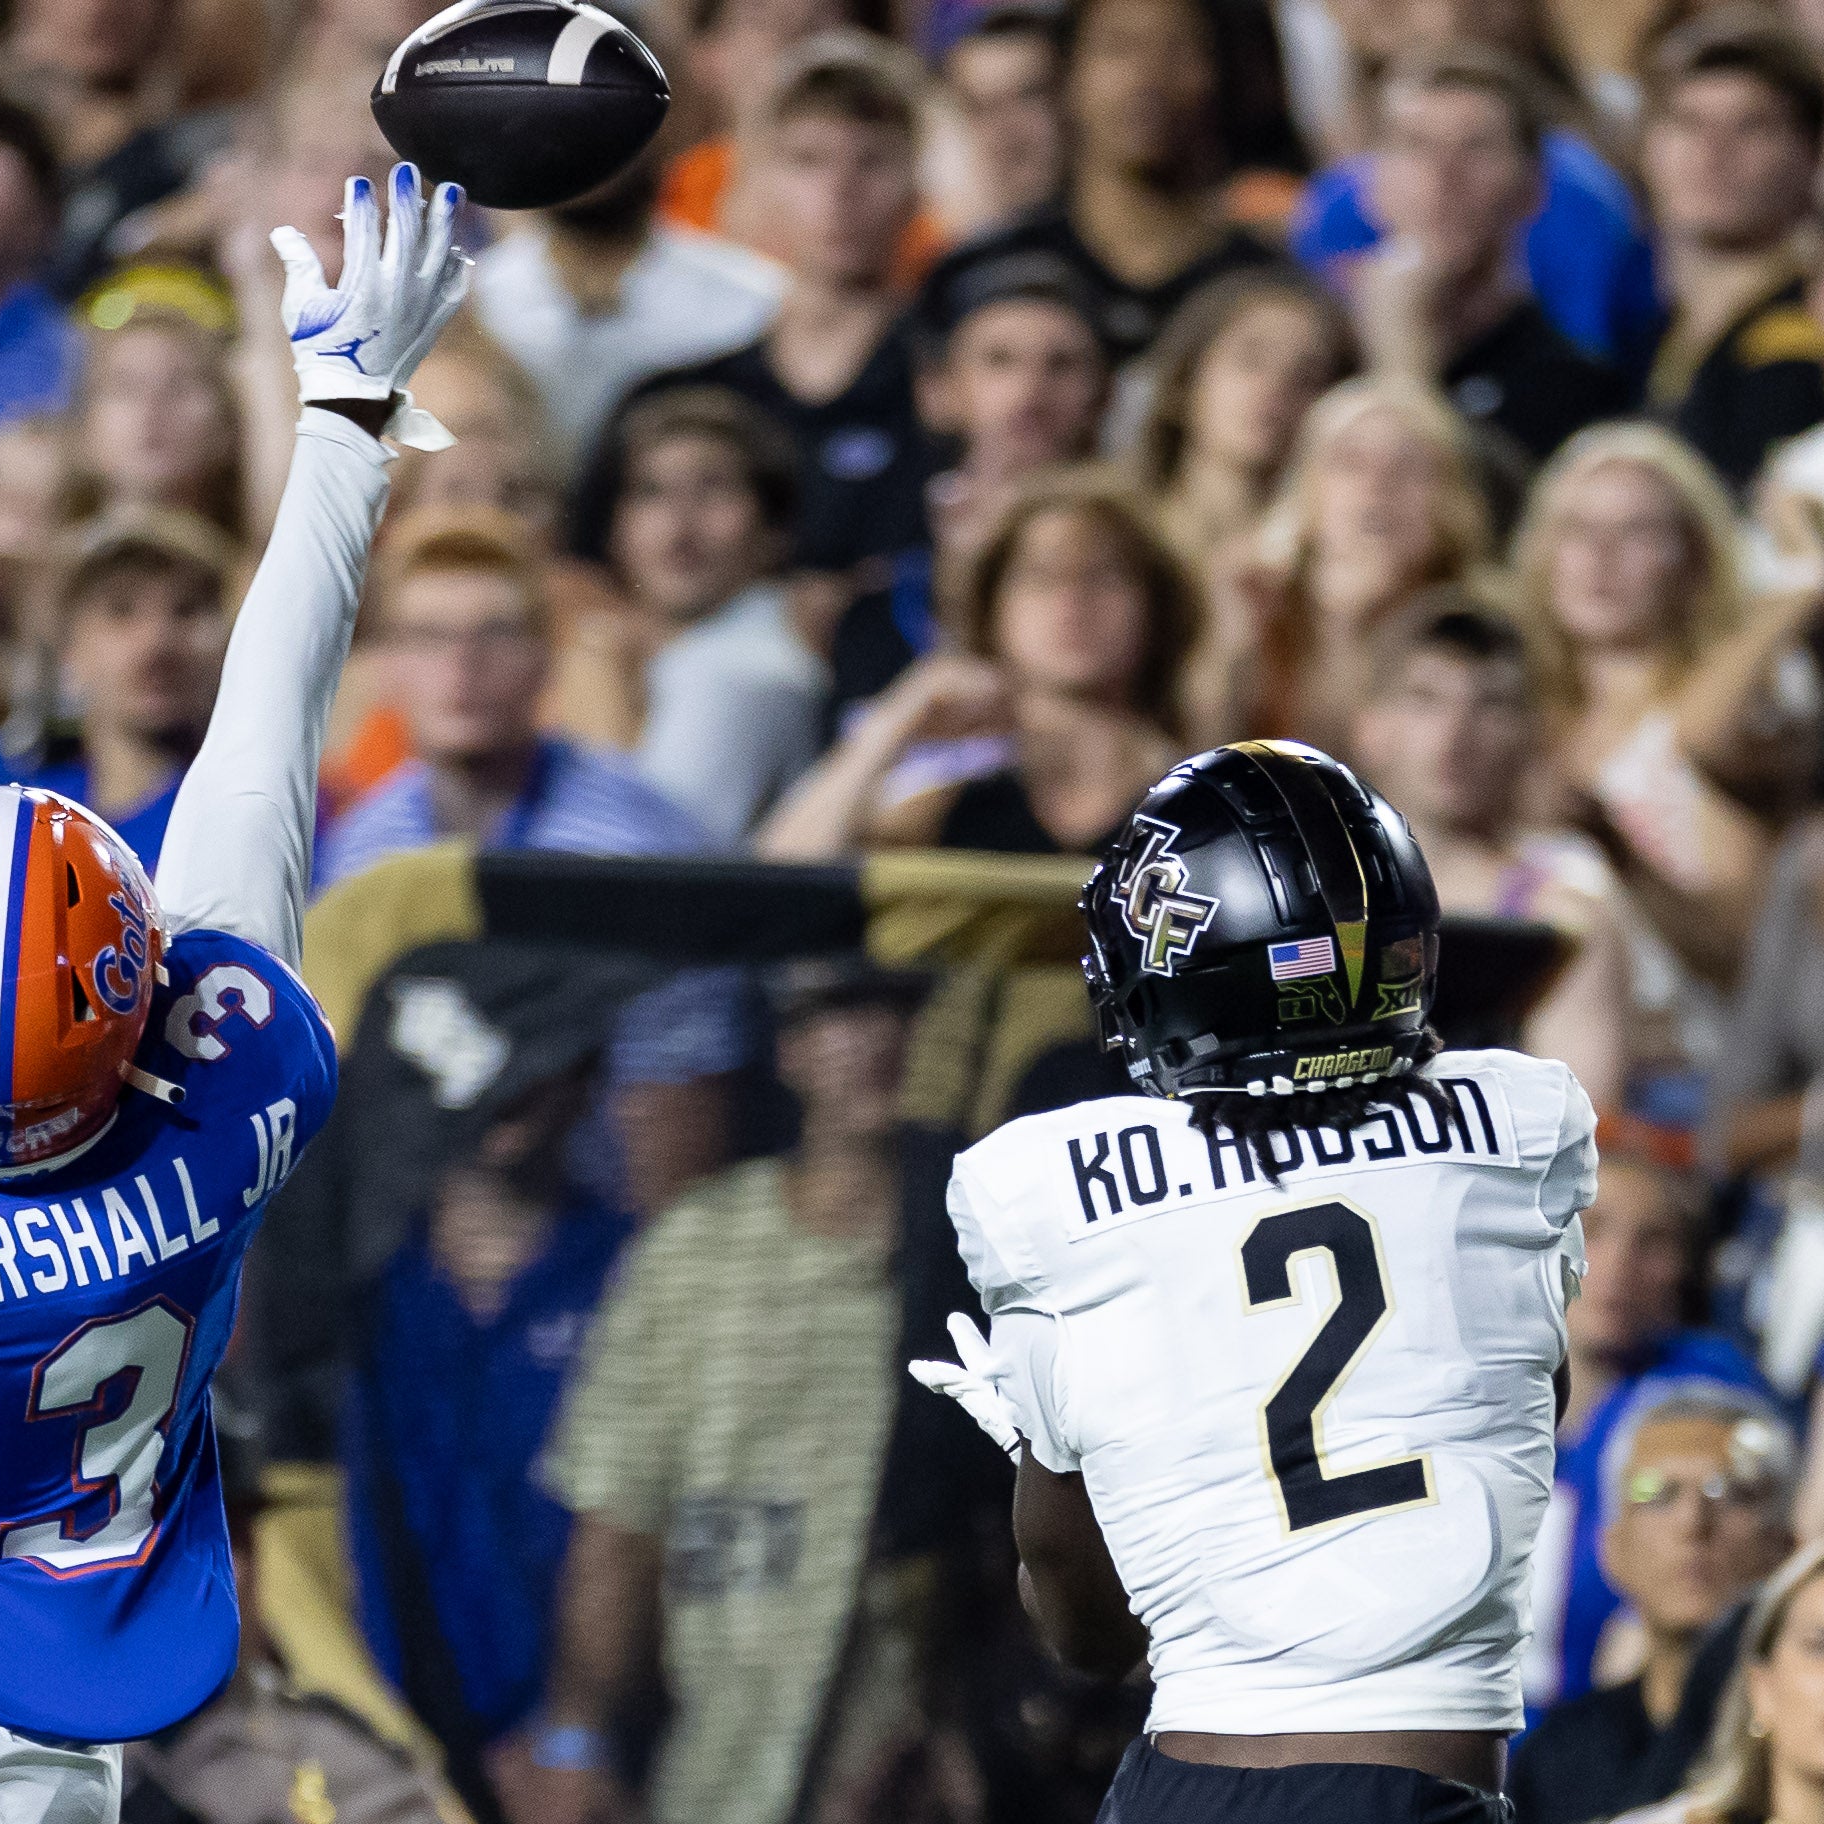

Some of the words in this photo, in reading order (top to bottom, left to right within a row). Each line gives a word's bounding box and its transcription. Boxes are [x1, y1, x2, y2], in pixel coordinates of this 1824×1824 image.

[1110, 813, 1221, 978] UCF
[166, 961, 274, 1063] 3
[241, 1096, 297, 1209] JR
[1067, 1123, 1193, 1224] KO.
[1233, 1193, 1440, 1541] 2
